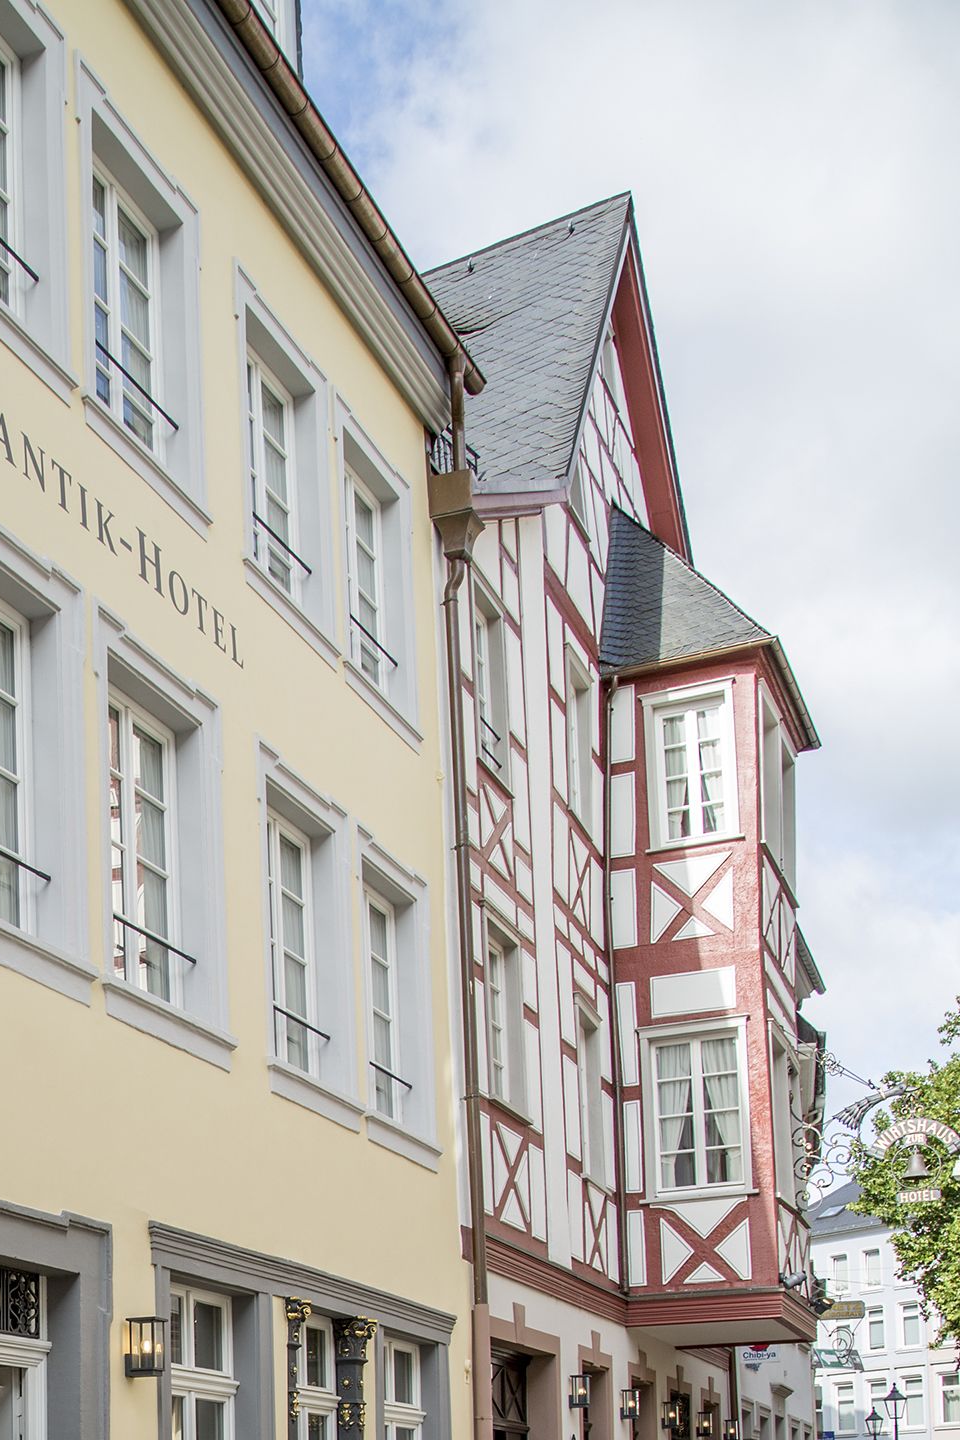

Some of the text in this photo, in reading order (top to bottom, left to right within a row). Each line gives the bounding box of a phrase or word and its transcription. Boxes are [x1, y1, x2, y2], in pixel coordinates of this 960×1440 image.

[874, 1119, 956, 1150] WIRTSHAUS
[905, 1133, 925, 1143] ZUR
[899, 1190, 938, 1203] HOTEL
[742, 1351, 777, 1360] Chibi-ya
